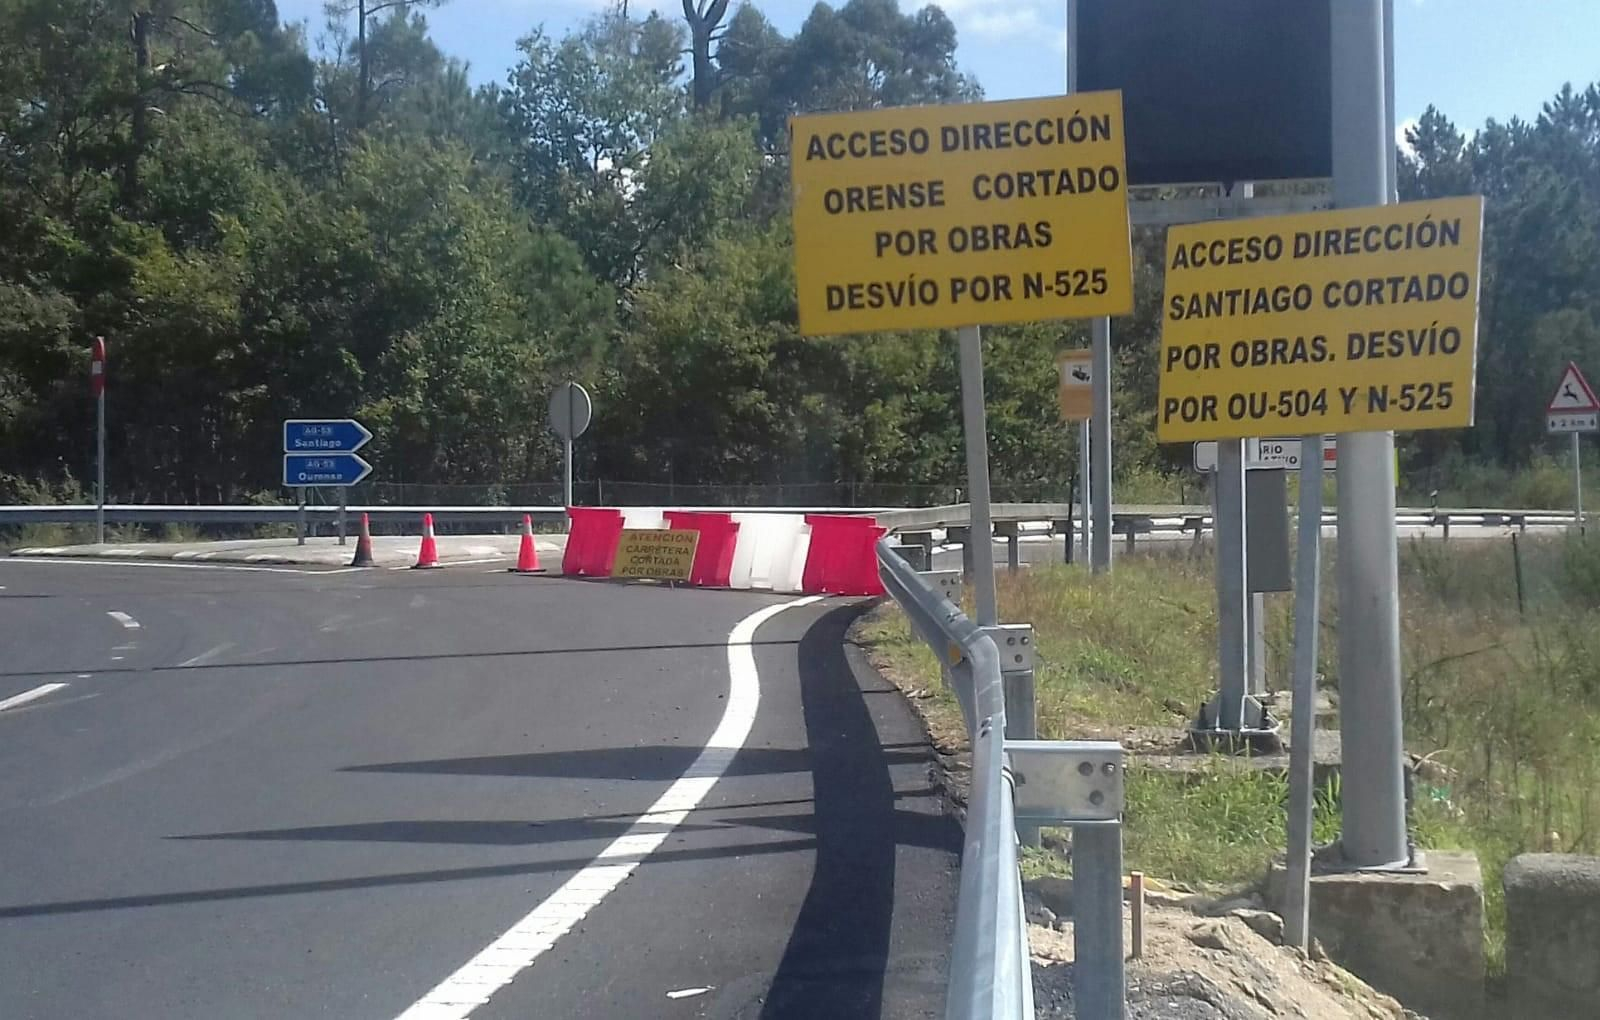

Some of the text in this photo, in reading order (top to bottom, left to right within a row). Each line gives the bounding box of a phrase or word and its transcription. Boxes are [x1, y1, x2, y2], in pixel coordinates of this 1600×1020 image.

[806, 109, 1111, 161] ACCESO DIRECCIÓN
[824, 165, 1120, 215] ORENSE CORTADO
[875, 221, 1052, 257] POR OBRAS
[1171, 215, 1461, 270] ACCESO DIRECCIÓN
[826, 268, 1108, 312] DESVÍO POR N-525
[1169, 271, 1470, 321] SANTIAGO CORTADO
[1166, 320, 1461, 373] POR OBRAS. DESVÍO
[1164, 382, 1454, 424] POR OU-504 Y N-525
[294, 438, 342, 449] Santiago
[622, 566, 684, 577] POR OBRAS
[626, 545, 689, 555] CARRETERA
[630, 555, 680, 566] CORTADA
